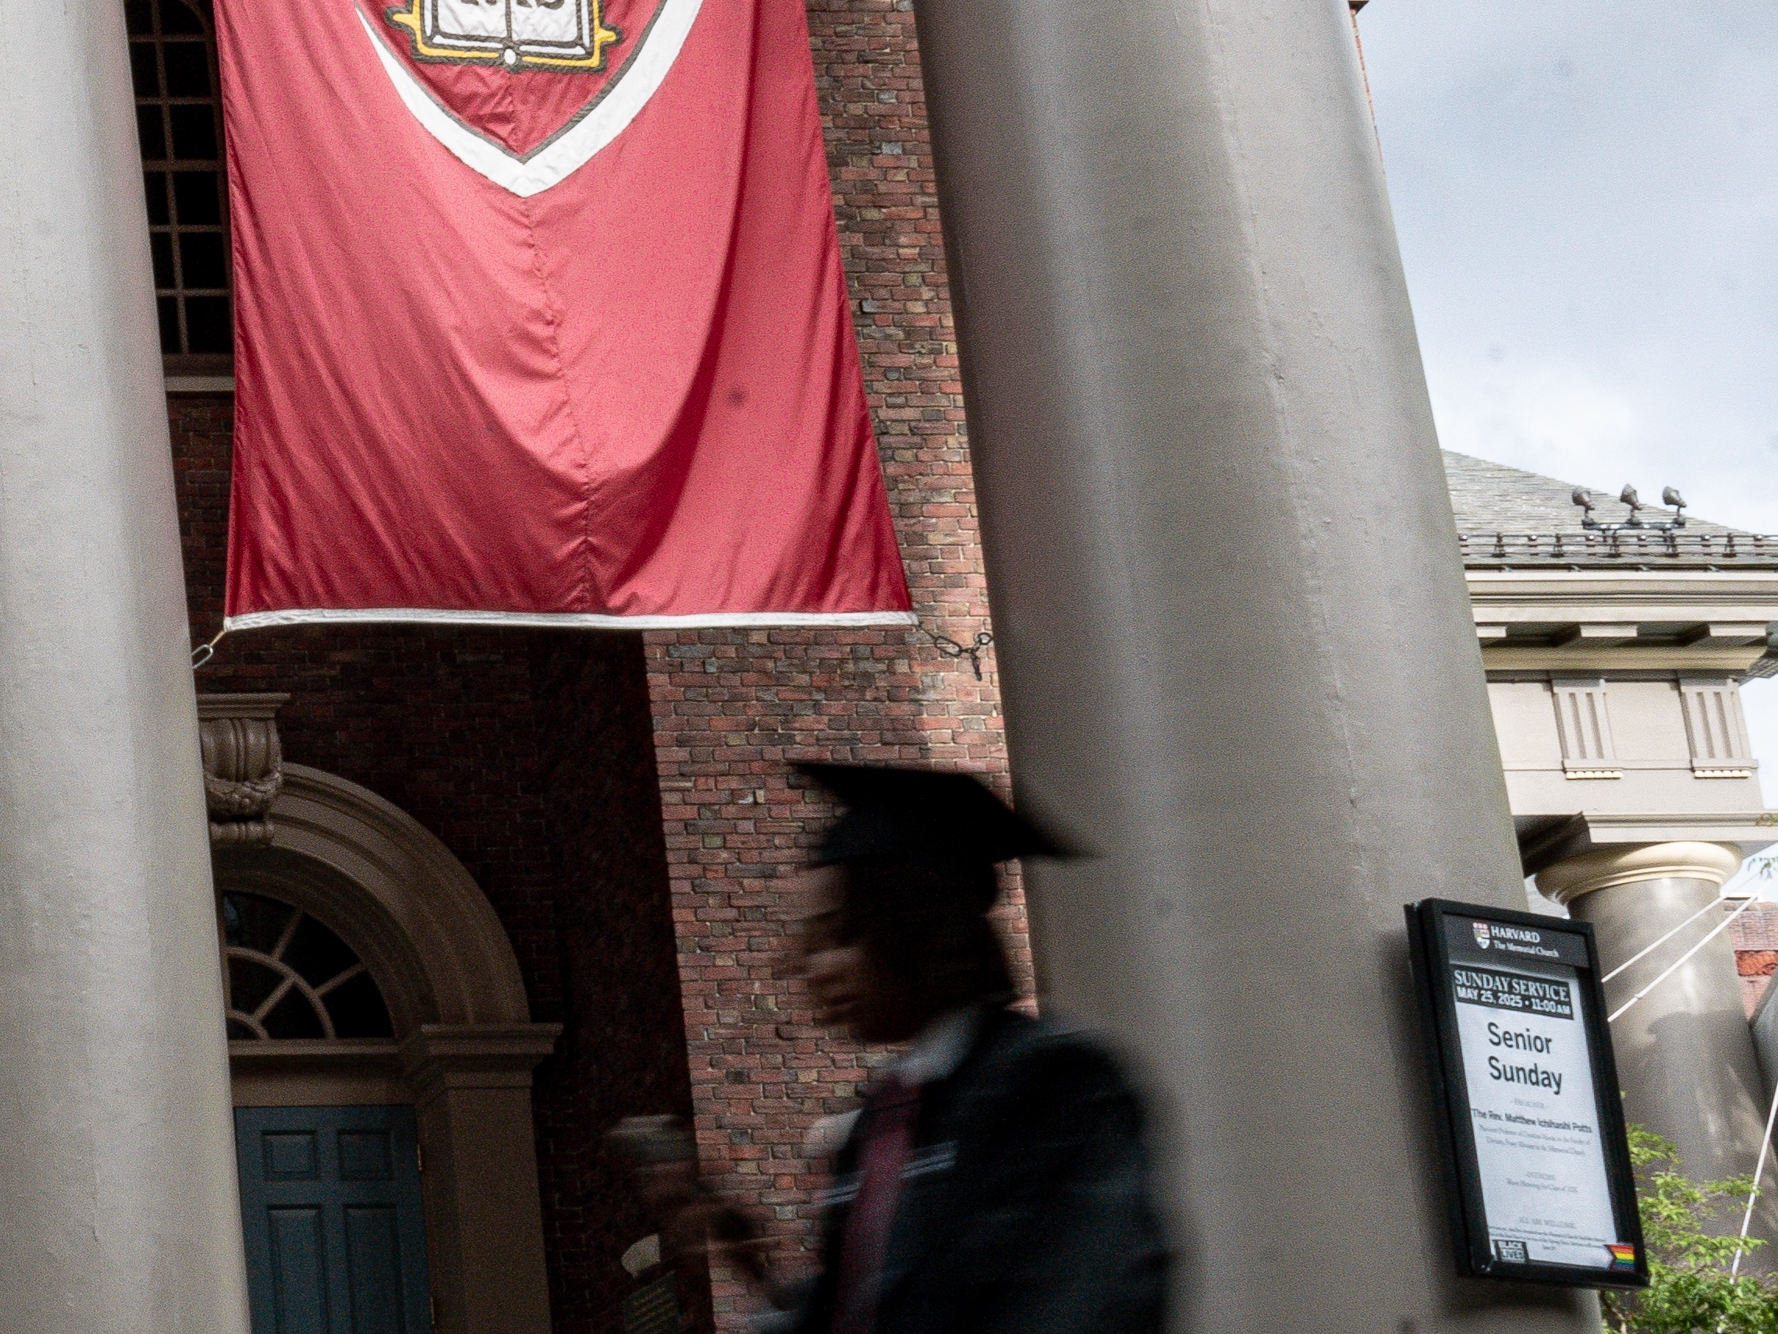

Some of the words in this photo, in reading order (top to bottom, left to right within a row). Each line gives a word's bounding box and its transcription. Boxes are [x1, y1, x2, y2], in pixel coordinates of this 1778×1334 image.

[1491, 925, 1541, 943] HARVARD
[1493, 940, 1506, 950] The
[1536, 947, 1560, 958] Church
[1454, 969, 1510, 992] SUNDAY
[1511, 978, 1569, 1002] SERVICE
[1456, 986, 1478, 1000] MAY
[1480, 990, 1497, 1004] 25,
[1497, 993, 1523, 1008] 2025
[1488, 1022, 1552, 1055] Senior
[1488, 1056, 1563, 1095] Sunday
[1471, 1107, 1487, 1119] The
[1488, 1110, 1503, 1121] Rev.
[1505, 1112, 1536, 1126] Matthew
[1572, 1121, 1593, 1133] Potts
